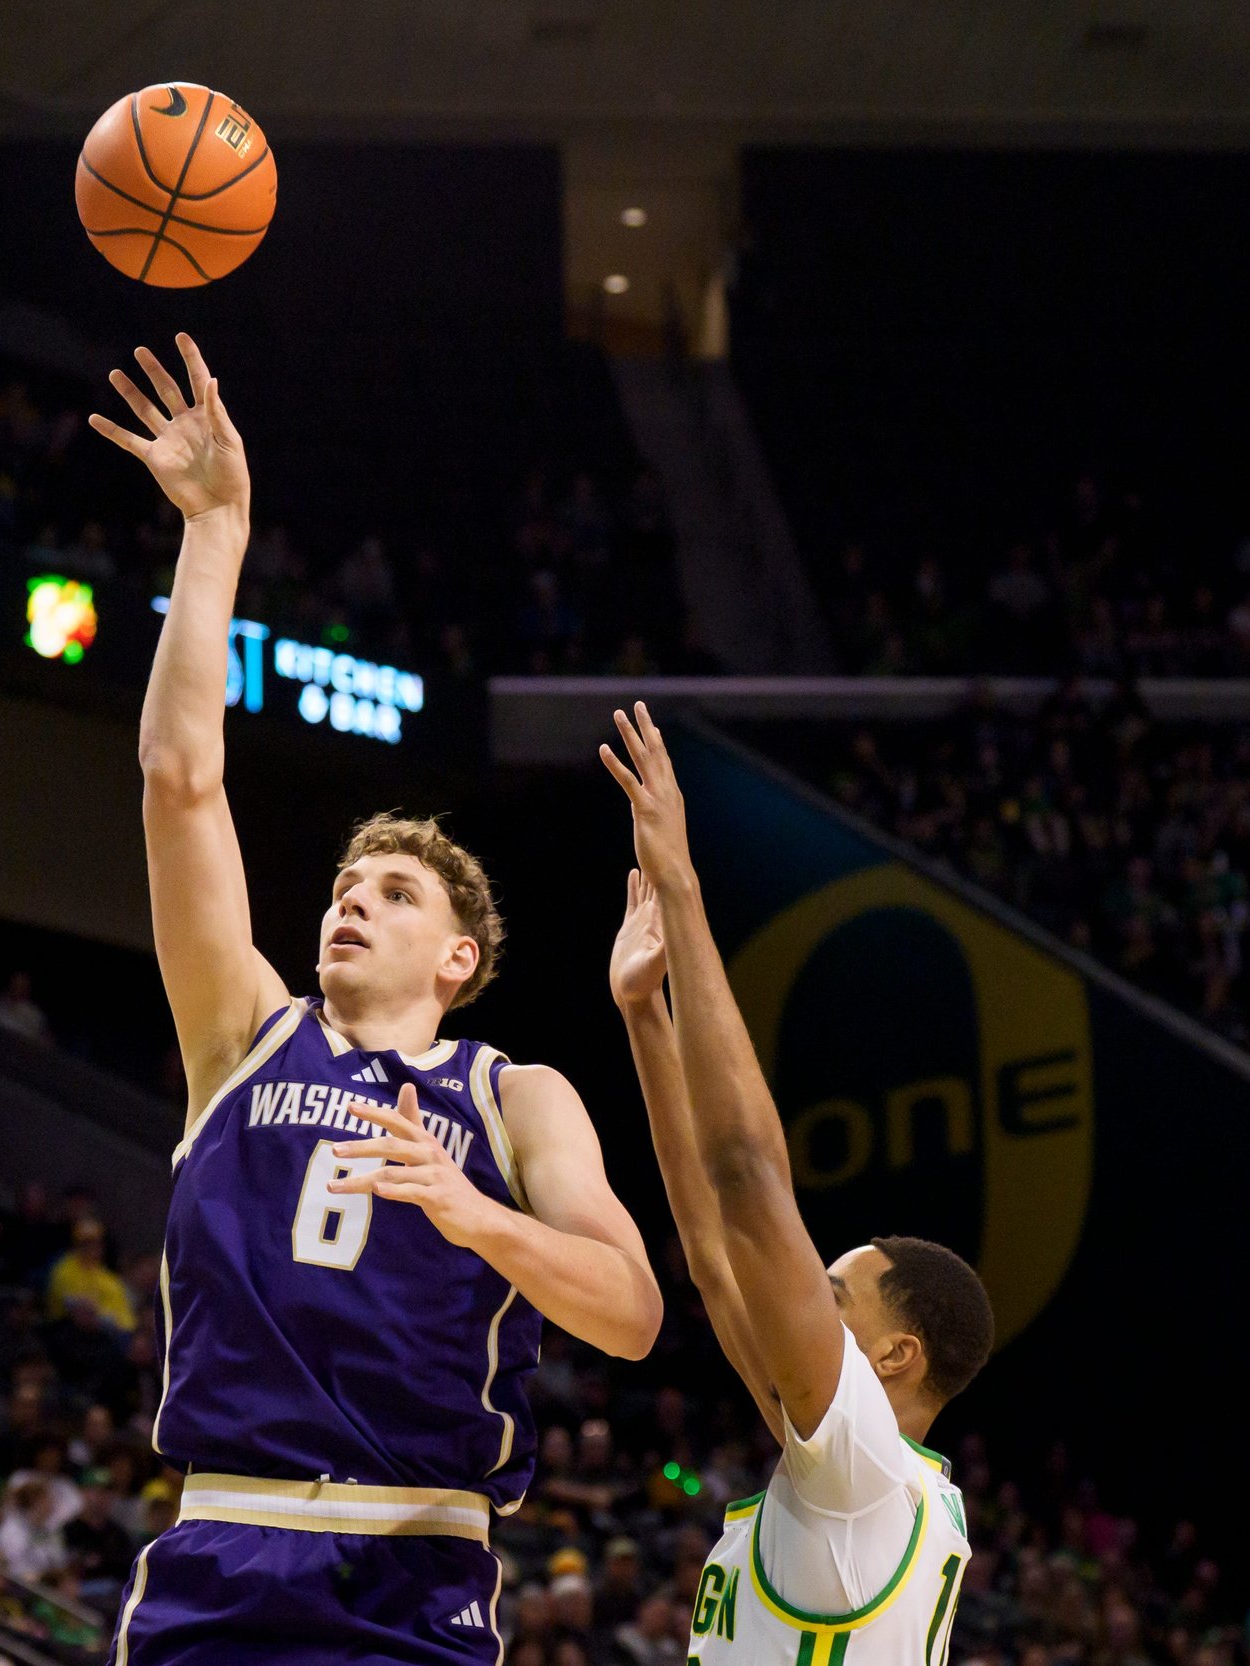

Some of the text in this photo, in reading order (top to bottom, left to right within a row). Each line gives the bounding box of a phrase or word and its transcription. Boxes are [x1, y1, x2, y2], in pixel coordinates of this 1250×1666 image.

[274, 637, 424, 713] KITCHEN
[329, 690, 402, 745] BAR
[291, 1138, 387, 1272] 6
